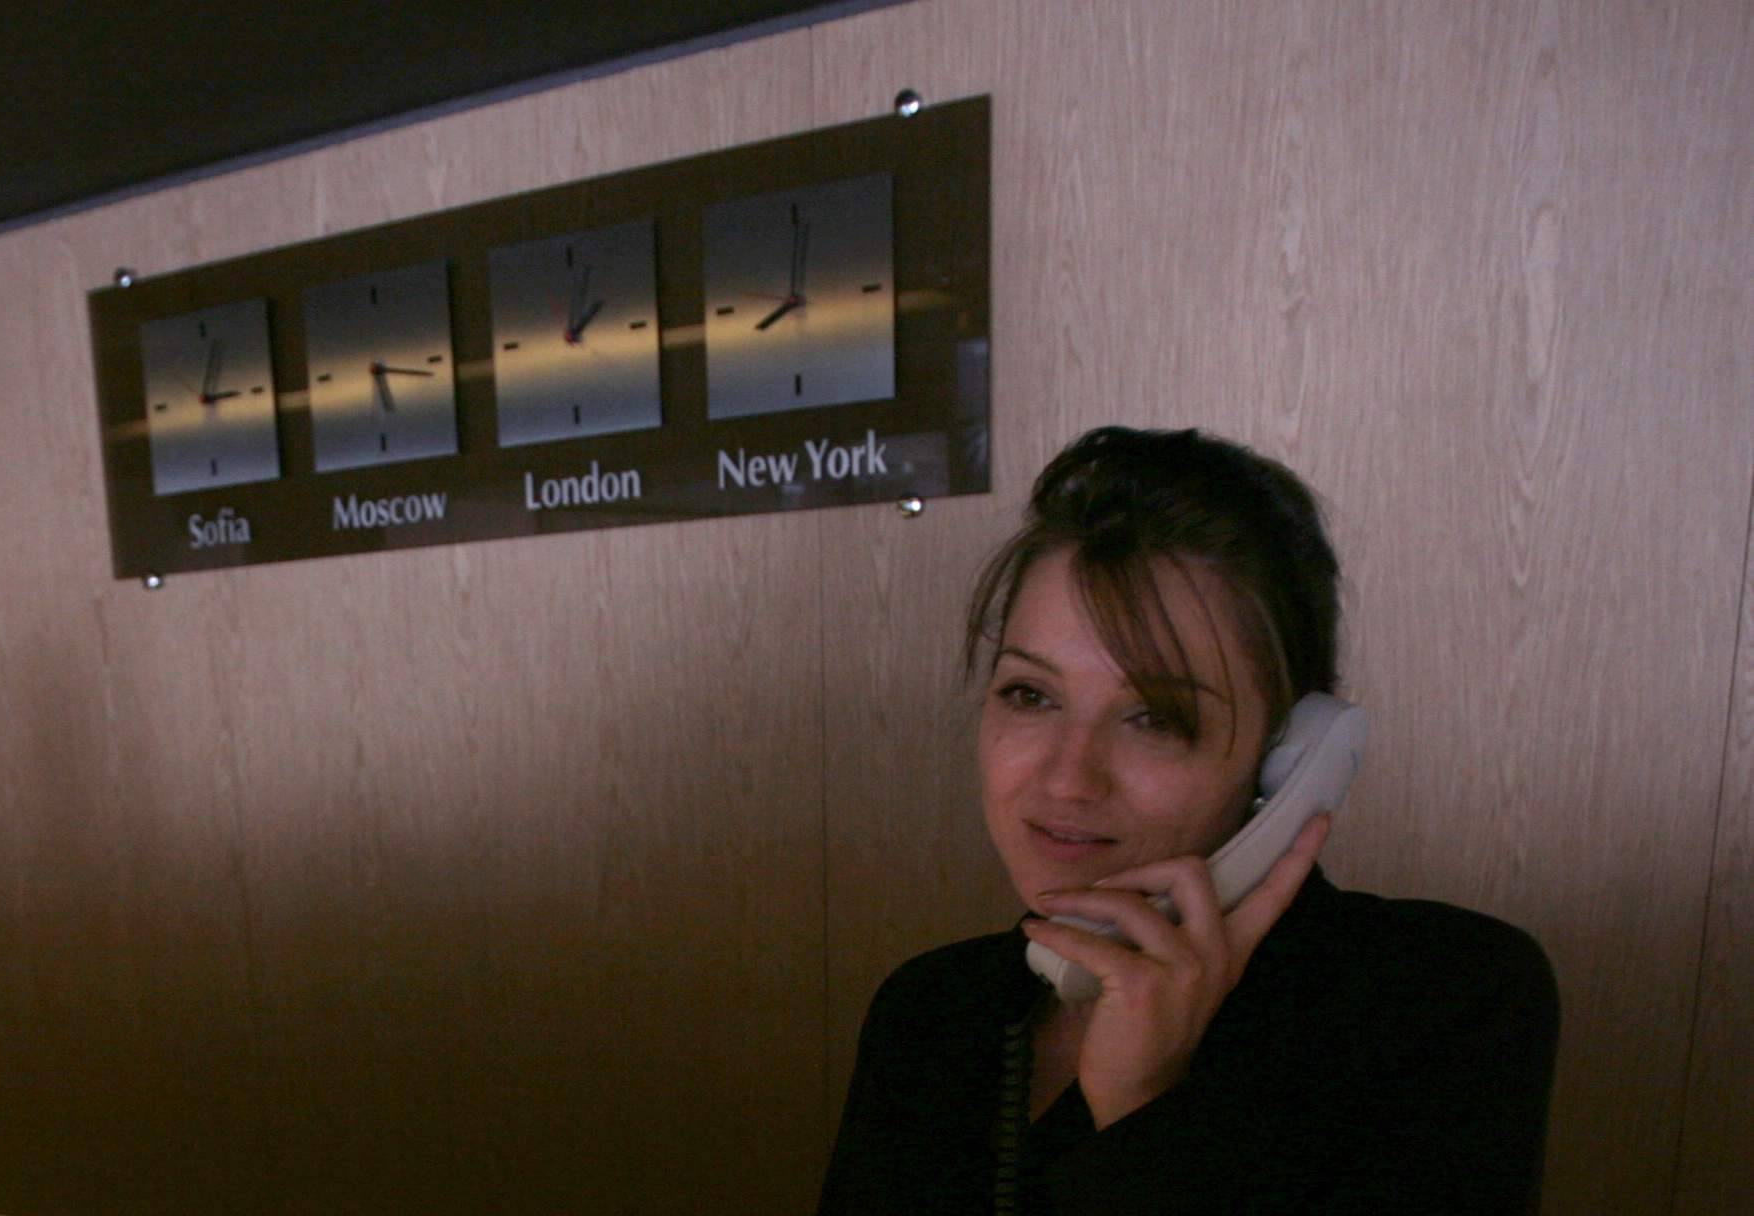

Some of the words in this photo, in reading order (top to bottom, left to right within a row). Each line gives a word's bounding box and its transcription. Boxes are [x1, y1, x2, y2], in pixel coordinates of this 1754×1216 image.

[718, 448, 798, 490] New
[804, 429, 888, 480] York
[524, 460, 642, 511] London
[188, 507, 252, 549] Sofia
[332, 492, 447, 530] Moscow
